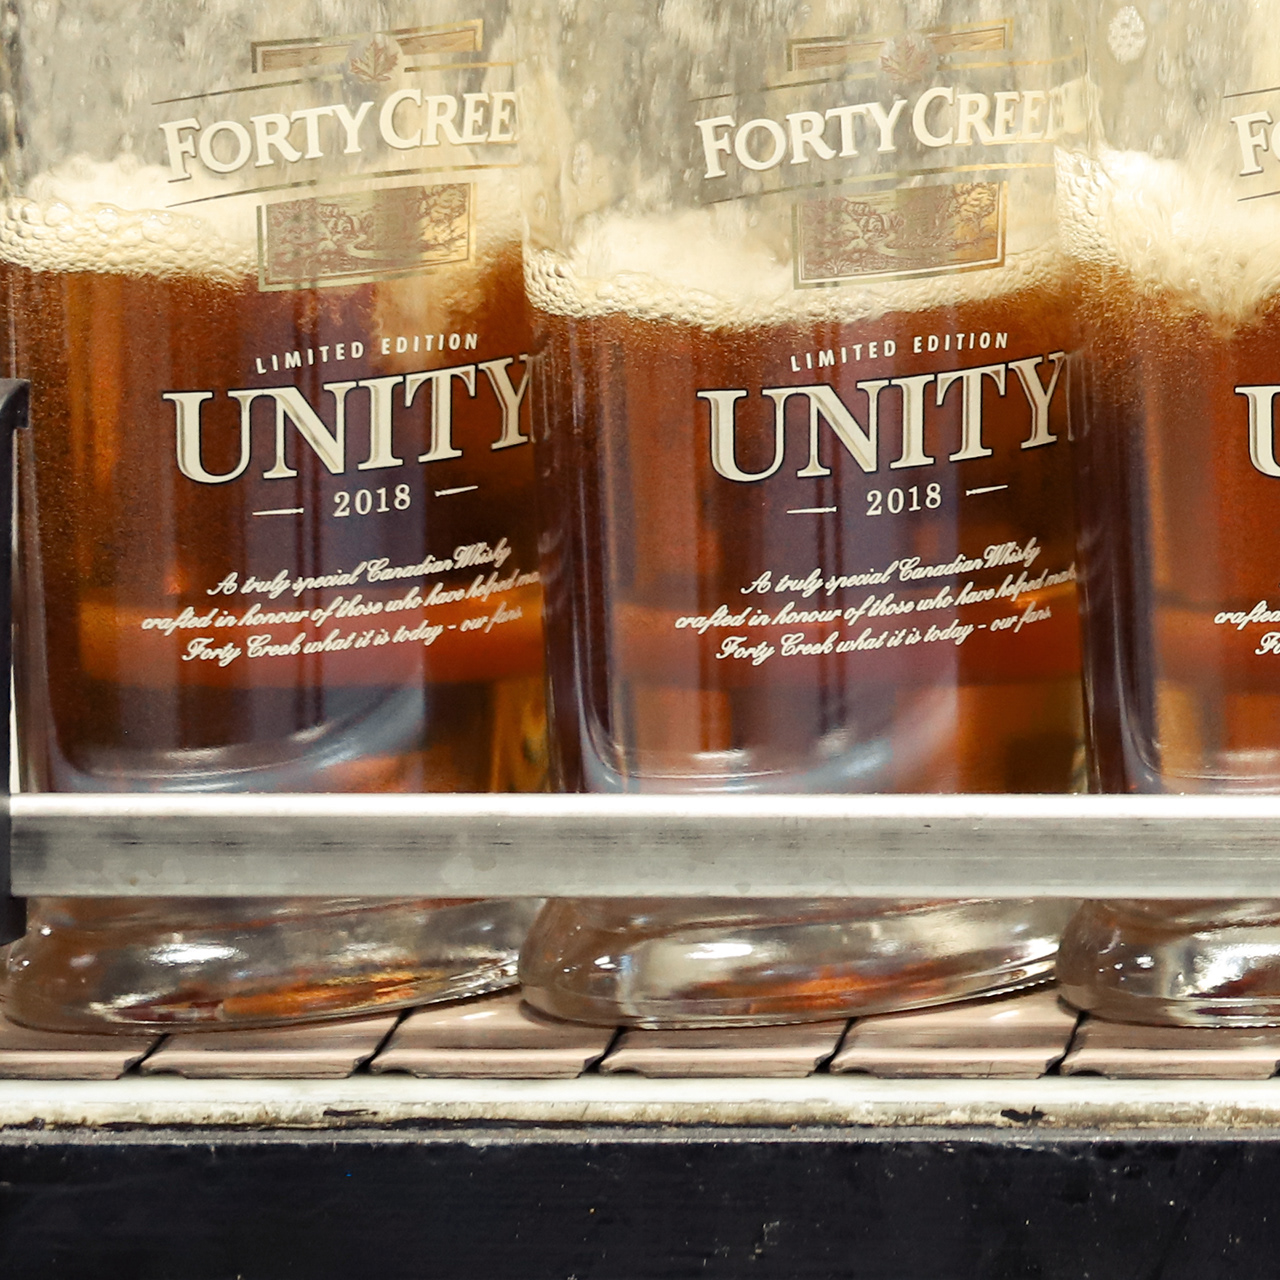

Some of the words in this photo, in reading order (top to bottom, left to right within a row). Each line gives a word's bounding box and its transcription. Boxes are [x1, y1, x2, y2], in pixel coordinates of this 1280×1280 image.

[160, 100, 373, 182] FORTY
[380, 89, 519, 149] CREE
[695, 99, 907, 179] FORTY
[256, 341, 365, 375] LIMITED
[381, 333, 479, 356] EDITION
[791, 340, 896, 372] LIMITED
[913, 332, 1009, 354] EDITION
[162, 354, 530, 486] UNITY
[697, 351, 1066, 482] UNITY
[333, 484, 412, 518] 2018
[866, 483, 942, 516] 2018
[740, 570, 772, 595] A
[774, 567, 825, 599] truly
[824, 560, 899, 597] special
[897, 553, 985, 582] Canadian
[982, 536, 1041, 569] Whisky
[674, 604, 754, 635] crafted
[747, 608, 772, 627] in
[770, 600, 843, 626] honour
[843, 594, 876, 627] of
[867, 592, 916, 618] those
[915, 585, 955, 612] who
[953, 581, 996, 607] have
[994, 568, 1049, 603] helped
[715, 635, 776, 667] Forty
[780, 630, 840, 657] Creek
[834, 627, 889, 654] what
[886, 628, 908, 648] it
[904, 627, 923, 646] is
[922, 618, 975, 646] today
[989, 615, 1019, 632] our
